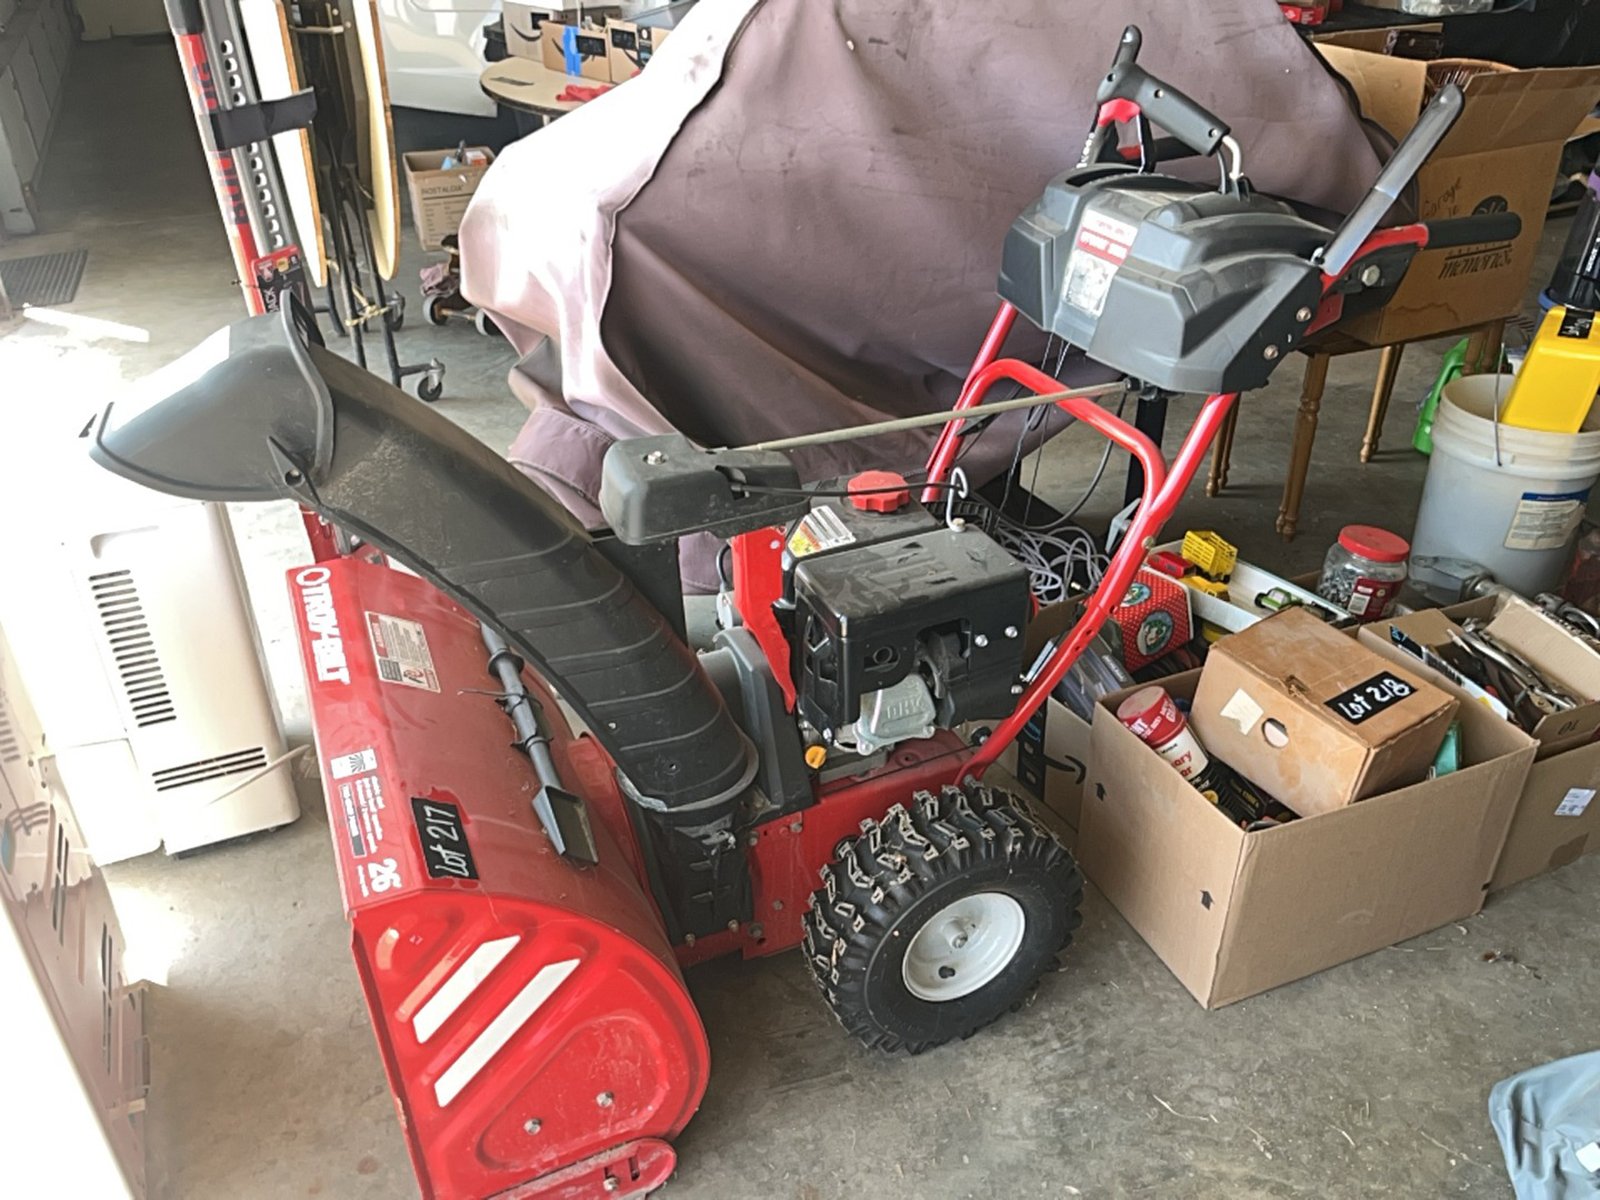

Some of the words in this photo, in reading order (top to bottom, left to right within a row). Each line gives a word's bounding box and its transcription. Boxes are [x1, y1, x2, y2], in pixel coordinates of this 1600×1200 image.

[1338, 693, 1372, 719] Lot
[1365, 678, 1410, 702] 218
[423, 805, 459, 841] 217
[368, 857, 402, 892] 26
[429, 843, 469, 877] Lot
